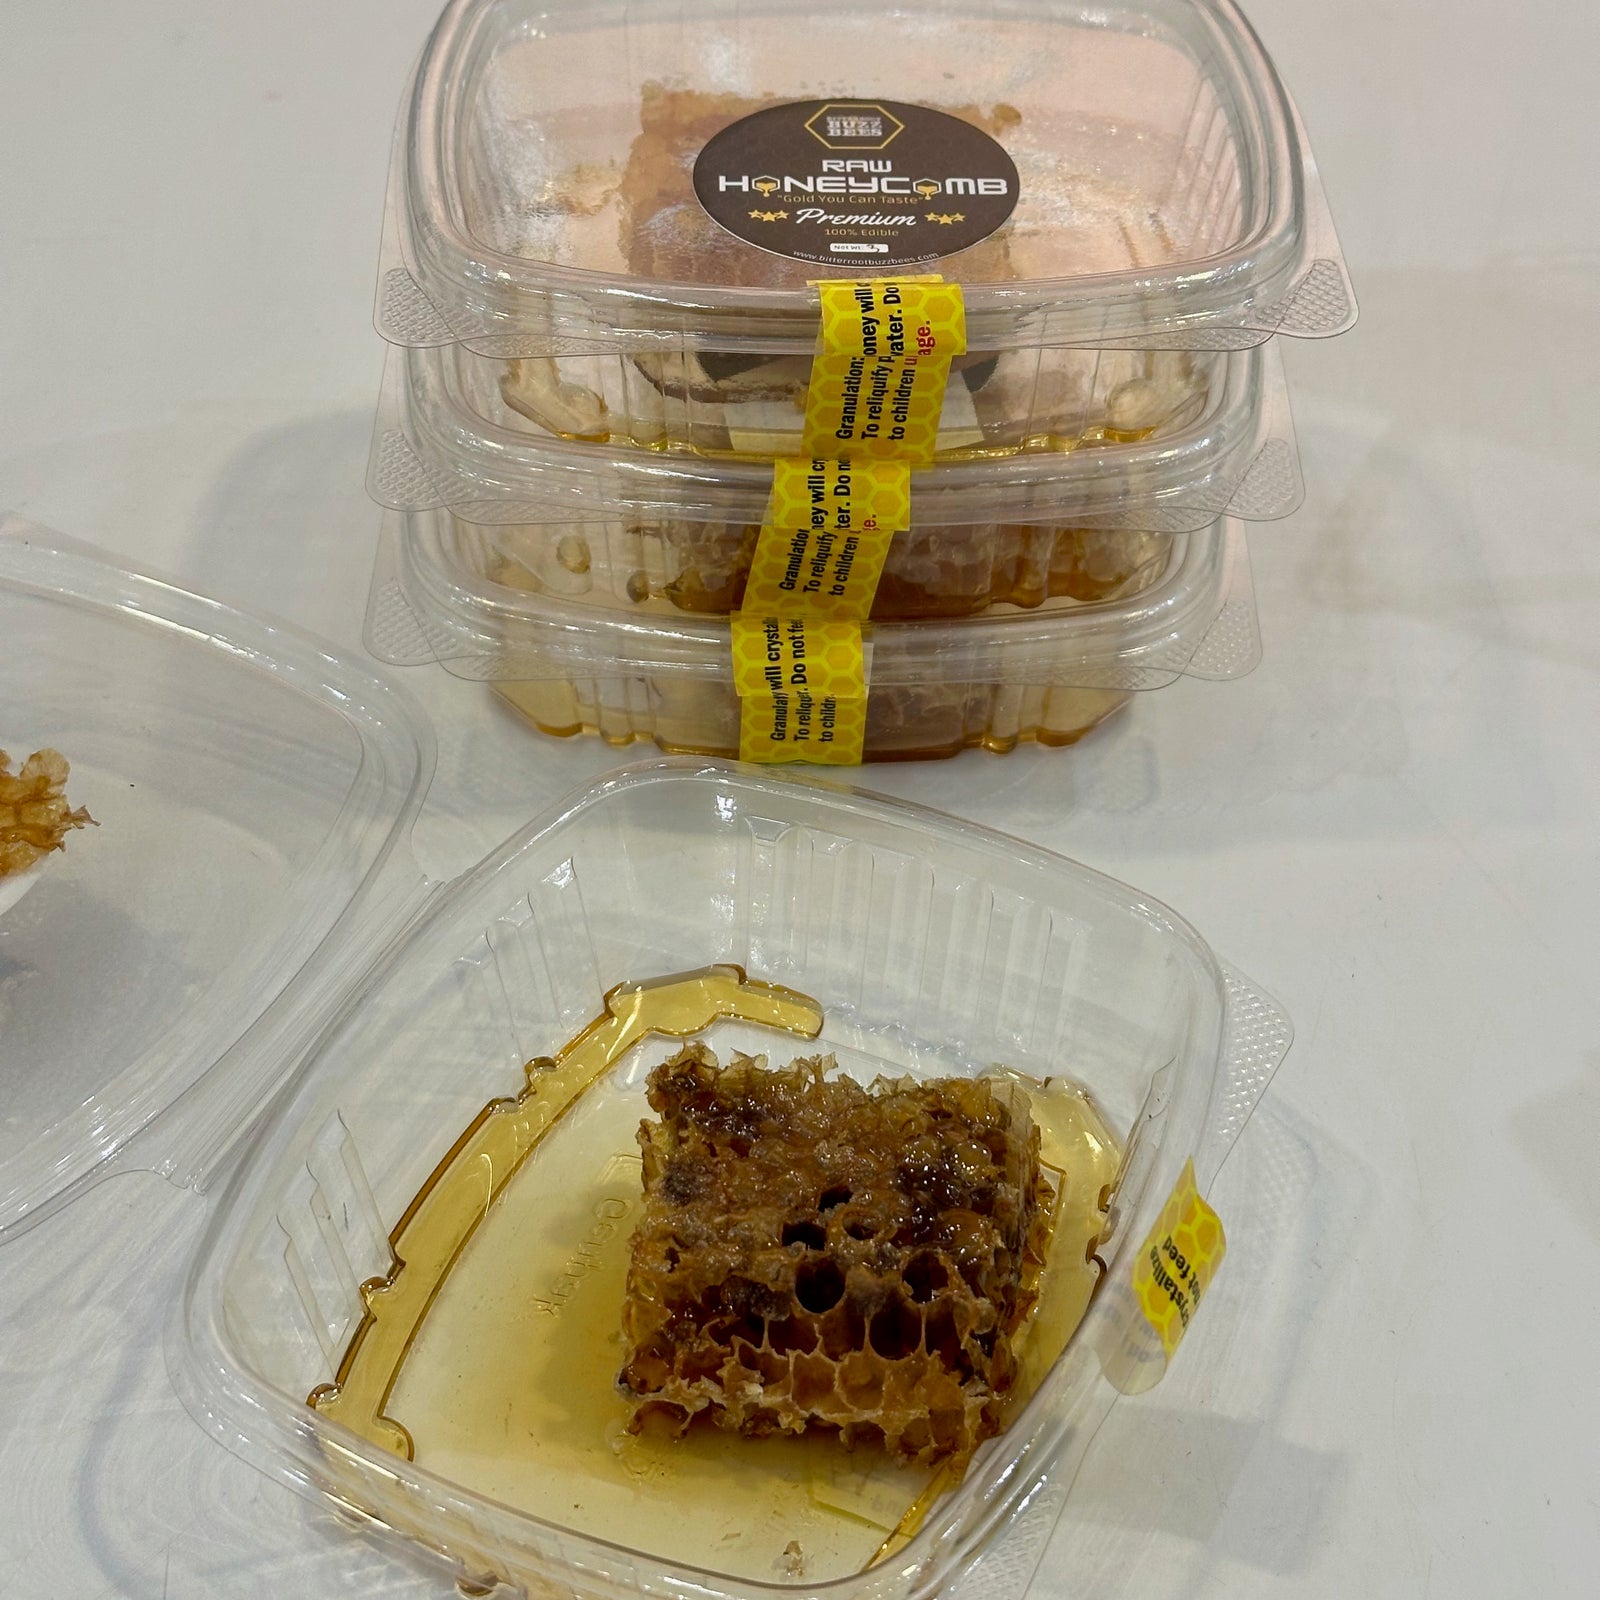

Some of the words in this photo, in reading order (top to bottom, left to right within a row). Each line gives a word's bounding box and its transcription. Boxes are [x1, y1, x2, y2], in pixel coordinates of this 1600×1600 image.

[822, 160, 892, 172] RAW
[718, 174, 1008, 199] HONEYCOMB
[818, 195, 845, 203] You
[849, 195, 876, 204] Can
[795, 208, 917, 226] Premium
[824, 228, 858, 236] 100%
[861, 228, 899, 237] Edible
[854, 288, 874, 313] will
[883, 286, 902, 305] Do
[916, 320, 936, 355] age.
[866, 366, 893, 420] reliquify
[890, 368, 916, 423] children
[861, 423, 880, 440] To
[888, 427, 905, 441] to
[808, 475, 825, 504] will
[834, 474, 852, 497] Do
[809, 531, 838, 579] reliquify
[832, 537, 860, 583] children
[803, 582, 821, 593] To
[828, 584, 845, 596] to
[789, 633, 805, 658] not
[764, 666, 783, 691] will
[791, 663, 808, 685] Do
[794, 730, 810, 742] To
[818, 732, 834, 743] to
[1162, 1235, 1191, 1280] feed
